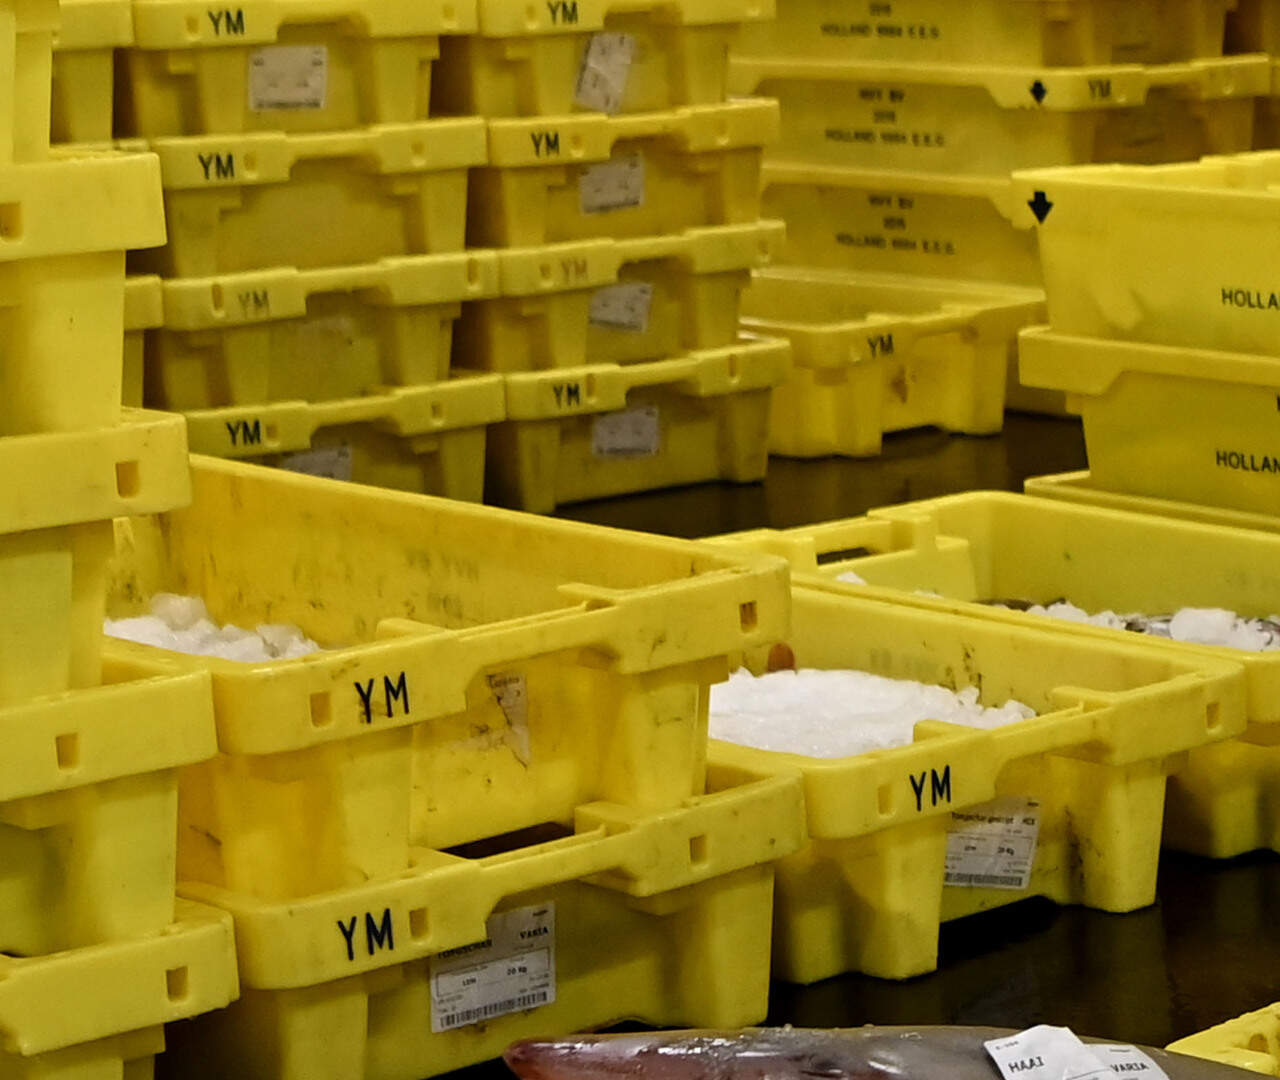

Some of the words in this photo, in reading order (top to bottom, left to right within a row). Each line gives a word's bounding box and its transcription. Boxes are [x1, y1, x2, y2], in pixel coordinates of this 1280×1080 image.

[208, 9, 245, 35] YM
[547, 0, 579, 24] YM
[531, 132, 560, 156] YM
[198, 153, 235, 180] YM
[560, 257, 588, 280] YM
[238, 290, 270, 312] YM
[867, 333, 894, 357] YM
[553, 383, 580, 406] YM
[226, 419, 261, 446] YM
[354, 671, 410, 724] YM
[910, 765, 951, 811] YM
[337, 908, 394, 961] YM
[1007, 1055, 1046, 1075] HAAI
[1109, 1061, 1150, 1074] VARIA
